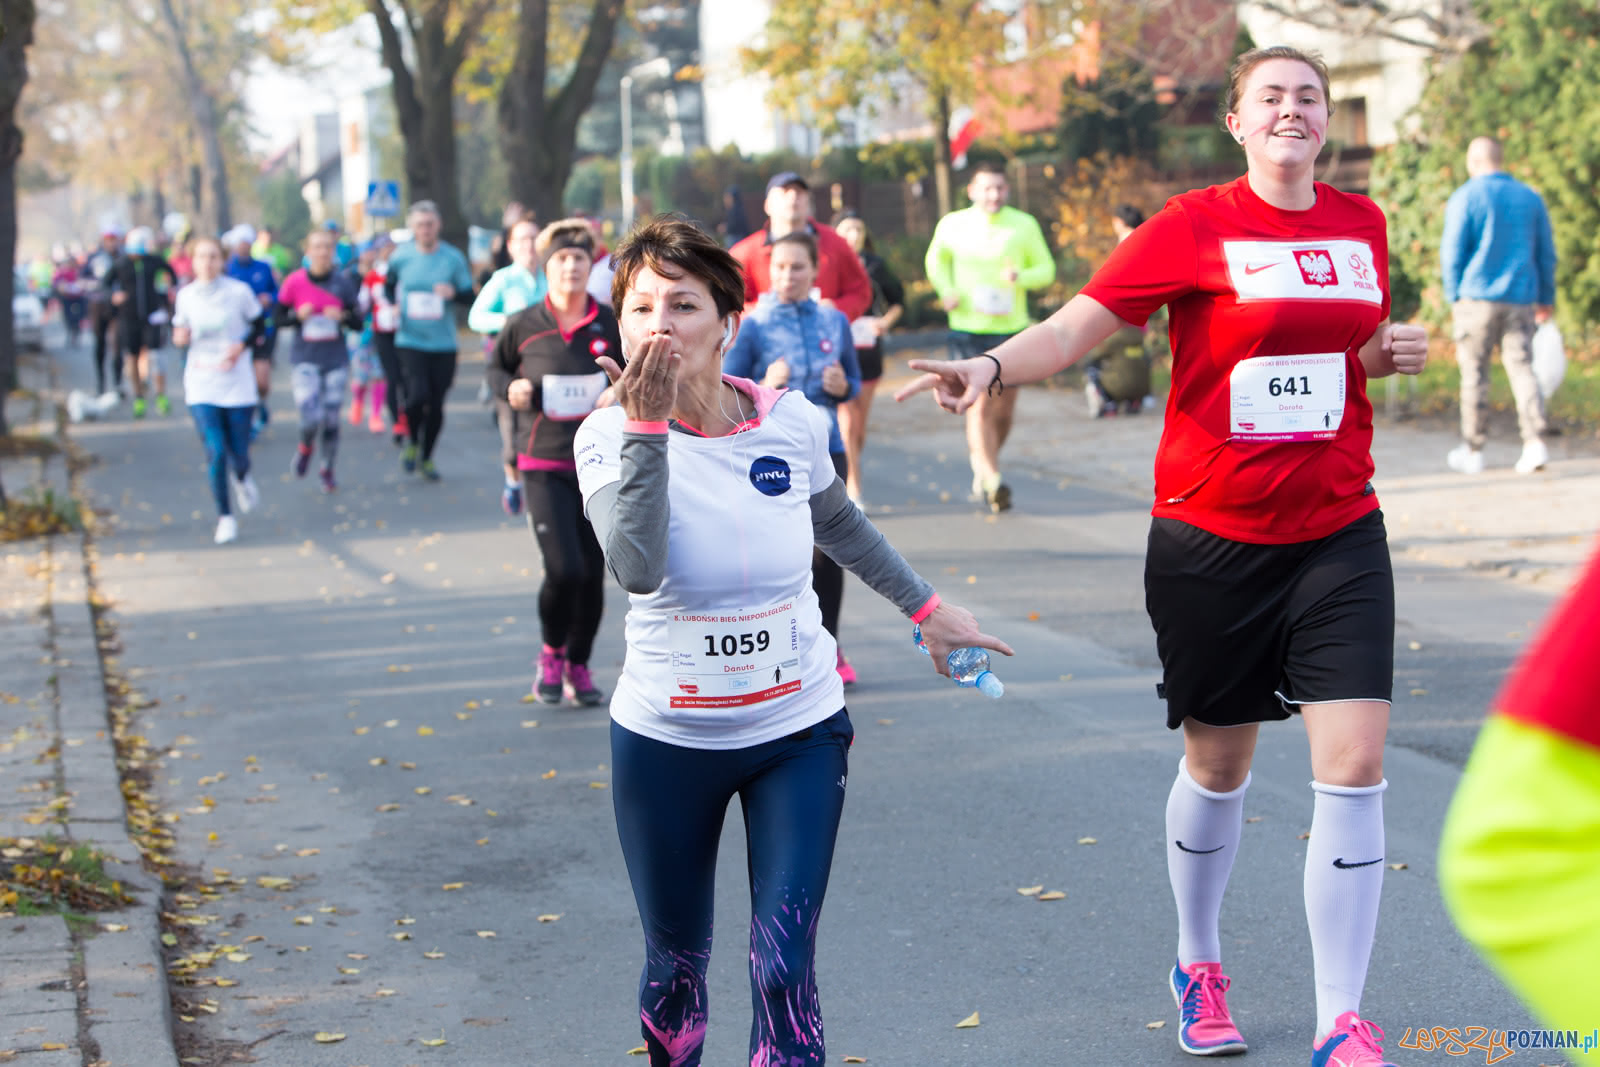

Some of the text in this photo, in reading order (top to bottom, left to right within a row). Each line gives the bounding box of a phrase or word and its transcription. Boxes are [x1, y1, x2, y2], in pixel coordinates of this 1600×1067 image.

[1268, 375, 1312, 396] 641
[1279, 403, 1304, 411] Dorota
[682, 613, 718, 623] LUBOŃSKI
[739, 602, 793, 622] NIEPODLEGŁOŚCI
[704, 630, 770, 657] 1059
[724, 664, 755, 672] Danuta
